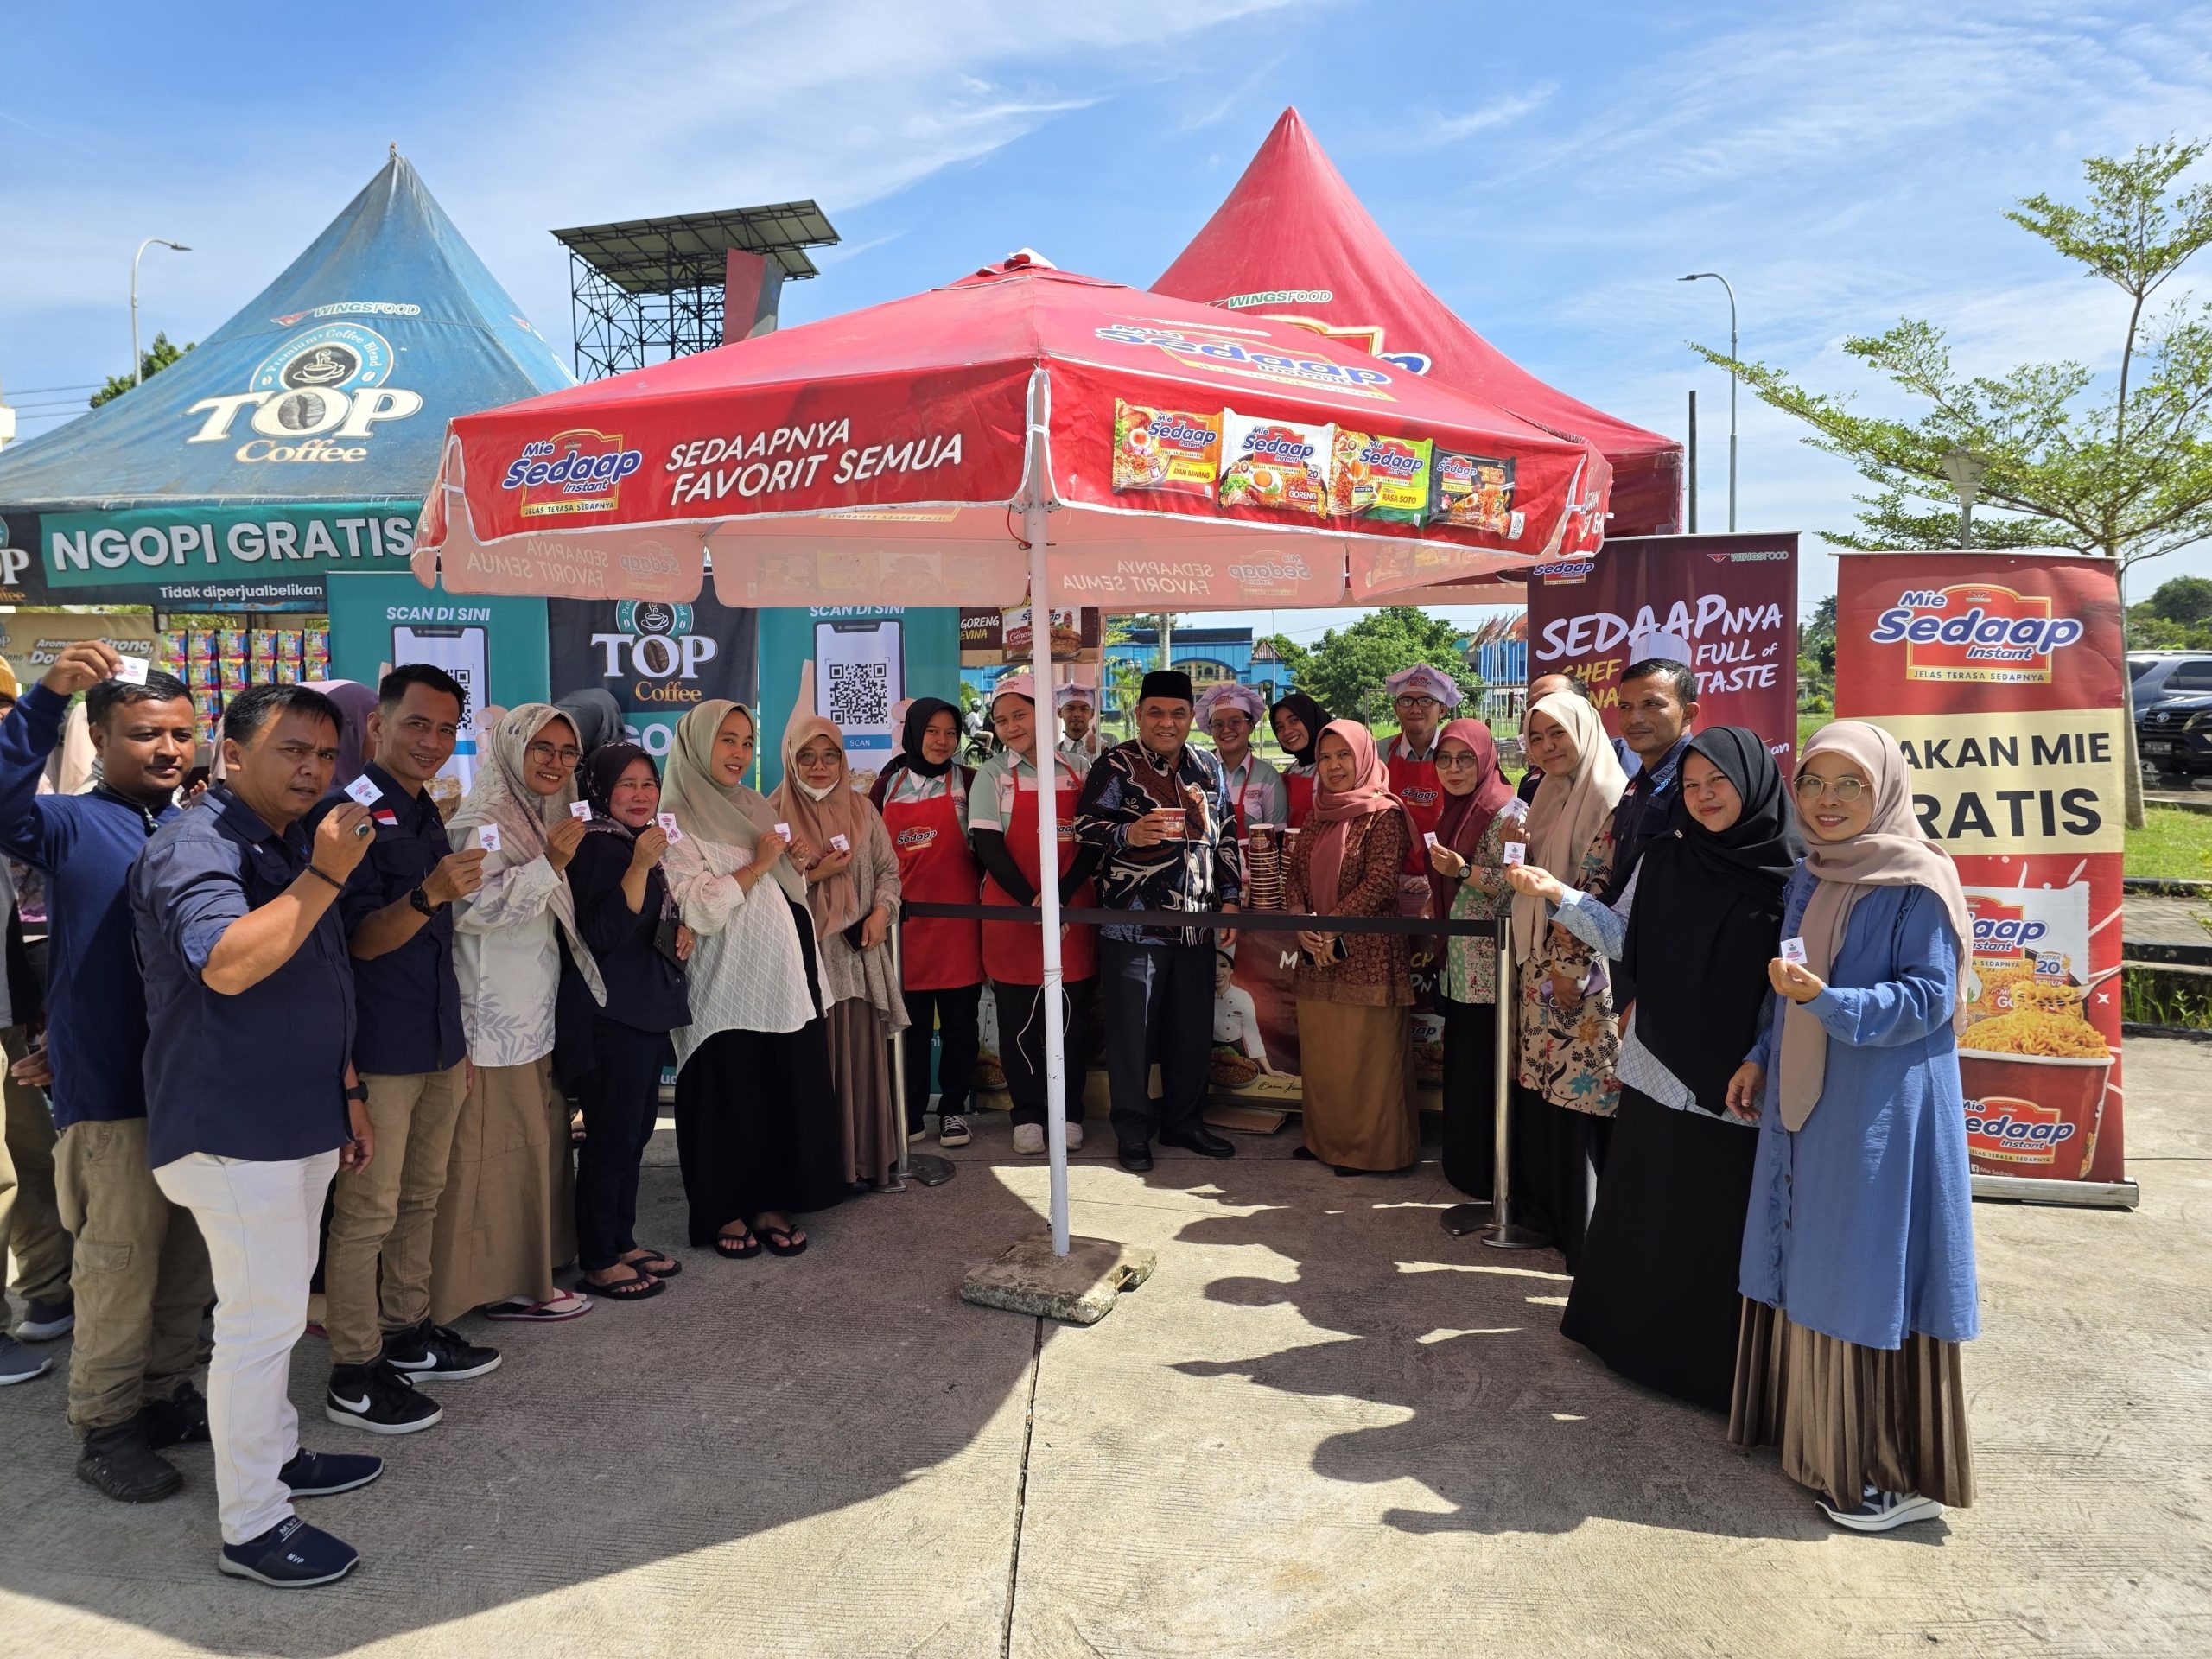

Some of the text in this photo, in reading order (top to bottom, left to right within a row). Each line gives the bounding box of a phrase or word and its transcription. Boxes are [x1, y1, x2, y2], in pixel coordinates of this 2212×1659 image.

[1228, 290, 1333, 308] WINGSFOOD
[313, 302, 421, 318] WINGSFOOD
[325, 329, 365, 344] Coffee
[363, 340, 382, 368] Blend
[1095, 327, 1392, 385] Sedaap
[186, 386, 423, 444] TOP
[1147, 421, 1217, 445] Sedaap
[1252, 427, 1268, 435] Mie
[235, 438, 367, 463] Coffee
[523, 440, 555, 457] Mie
[666, 418, 849, 471] SEDAAPNYA
[1242, 434, 1315, 461] Sedaap
[1338, 440, 1357, 452] 20
[502, 449, 642, 489] Sedaap
[1229, 461, 1249, 474] 20
[1358, 448, 1424, 472] Sedaap
[1437, 461, 1478, 476] Sedaap
[671, 434, 963, 505] FAVORIT SEMUA
[563, 479, 608, 493] Instant
[1288, 490, 1317, 500] GORENG
[1382, 493, 1417, 505] RASA SOTO
[525, 506, 544, 515] JELAS
[576, 502, 613, 511] SEDAPNYA
[52, 524, 219, 571] NGOPI
[227, 517, 414, 563] GRATIS
[1731, 550, 1789, 562] WINGSFOOD
[1534, 562, 1595, 575] Sedaap
[159, 583, 323, 601] Tidak diperjualbelikan
[1898, 589, 1948, 609] Mie
[386, 607, 490, 621] SCAN DI SINI
[810, 606, 852, 617] SCAN
[856, 606, 873, 615] DI
[960, 615, 1000, 630] GORENG
[1535, 594, 1783, 661] SEDAAPNYA
[1870, 607, 2083, 654] Sedaap
[960, 628, 988, 640] EVINA
[590, 633, 718, 679] TOP
[1695, 639, 1777, 666] FULL of
[1966, 645, 2035, 661] Instant
[1694, 663, 1779, 695] TASTE
[1914, 670, 2044, 682] JELAS TERASA SEDAPNYA
[635, 680, 702, 702] Coffee
[1900, 732, 2111, 770] AKAN MIE
[1912, 788, 2101, 840] RATIS
[897, 830, 937, 845] Sedaap
[1966, 1115, 2075, 1145] edaap
[2001, 1140, 2045, 1150] Instant
[1987, 1152, 2013, 1160] TERASA
[287, 1552, 304, 1564] MVP
